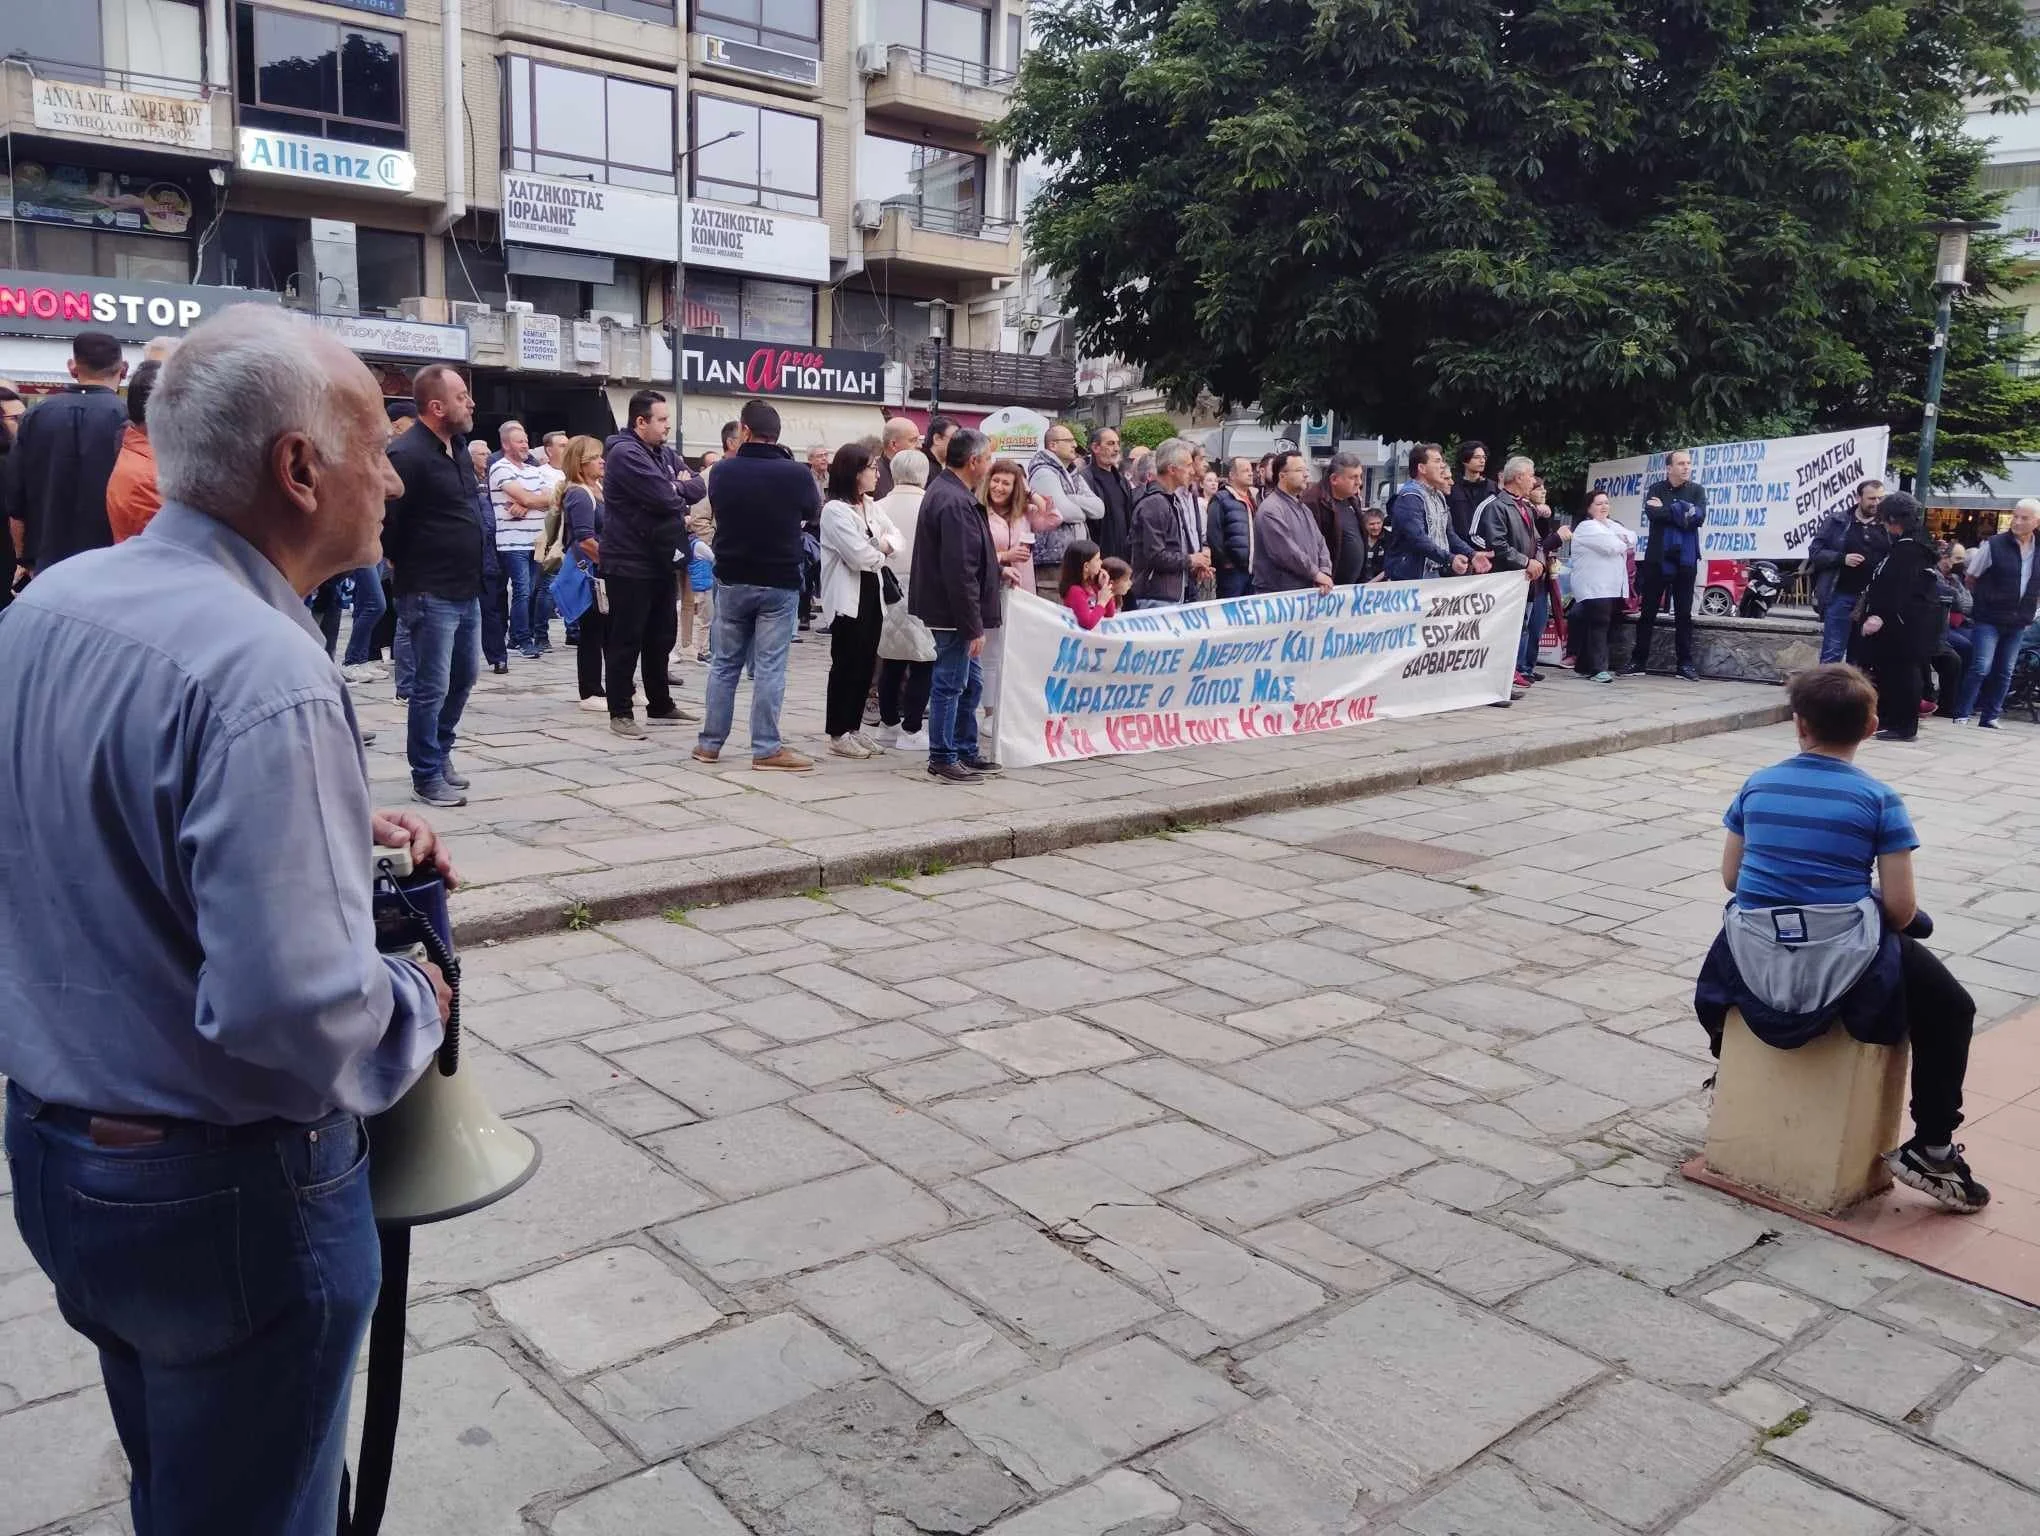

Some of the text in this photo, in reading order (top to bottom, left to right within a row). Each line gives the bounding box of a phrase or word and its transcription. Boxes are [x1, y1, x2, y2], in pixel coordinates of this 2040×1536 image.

[43, 87, 84, 111] ΑΝΝΑ
[120, 98, 202, 126] ΑΝΔΡΕΑΔΟΥ
[251, 137, 370, 179] Allianz
[508, 179, 604, 211] ΧΑΤΖΗΚΩΣΤΑΣ
[508, 200, 576, 227] ΙΟΡΔΑΝΗΣ
[691, 207, 774, 236] ΧΑΤΖΗΚΩΣΤΑΣ
[691, 227, 744, 250] ΚΩΝ/ΝΟΣ
[1704, 442, 1765, 465] ΕΡΓΟΣΤΑΣΙΑ
[1796, 438, 1855, 487] ΣΩΜΑΤΕΙΟ
[1701, 463, 1758, 485] ΔΙΚΑΙΩΜΑΤΑ
[1796, 457, 1864, 515] ΕΡΓ/ΜΕΝΩΝ
[1736, 483, 1763, 503] ΤΟΠΟ
[1766, 481, 1790, 502] ΜΑΣ
[1707, 507, 1767, 527] ΠΑΙΔΙΑ ΜΑΣ
[1705, 533, 1757, 552] ΦΤΩΧΕΙΑΣ
[1221, 592, 1346, 626] ΜΕΓΑΛΥΤΕΡΟΥ
[1352, 585, 1422, 617] ΚΕΡΔΟΥΣ
[1425, 593, 1496, 618] ΣΩΜΑΤΕΙΟ
[1053, 624, 1416, 675] ΜΑΣ ΑΦΗΣΕ ΑΝΕΡΓΟΥΣ ΚΑΙ ΑΠΛΗΡΩΤΟΥΣ
[1402, 646, 1490, 679] ΒΑΡΒΑΡΕΣΟΥ
[1045, 676, 1154, 715] ΜΑΡΑΖΩΣΕ
[1185, 675, 1244, 706] ΤΟΠΟΣ
[1251, 668, 1295, 703] ΜΑΣ
[1106, 713, 1185, 752] ΚΕΡΔΗ
[1292, 699, 1344, 734] ΖΩΕΣ
[1347, 696, 1378, 723] ΜΑΣ
